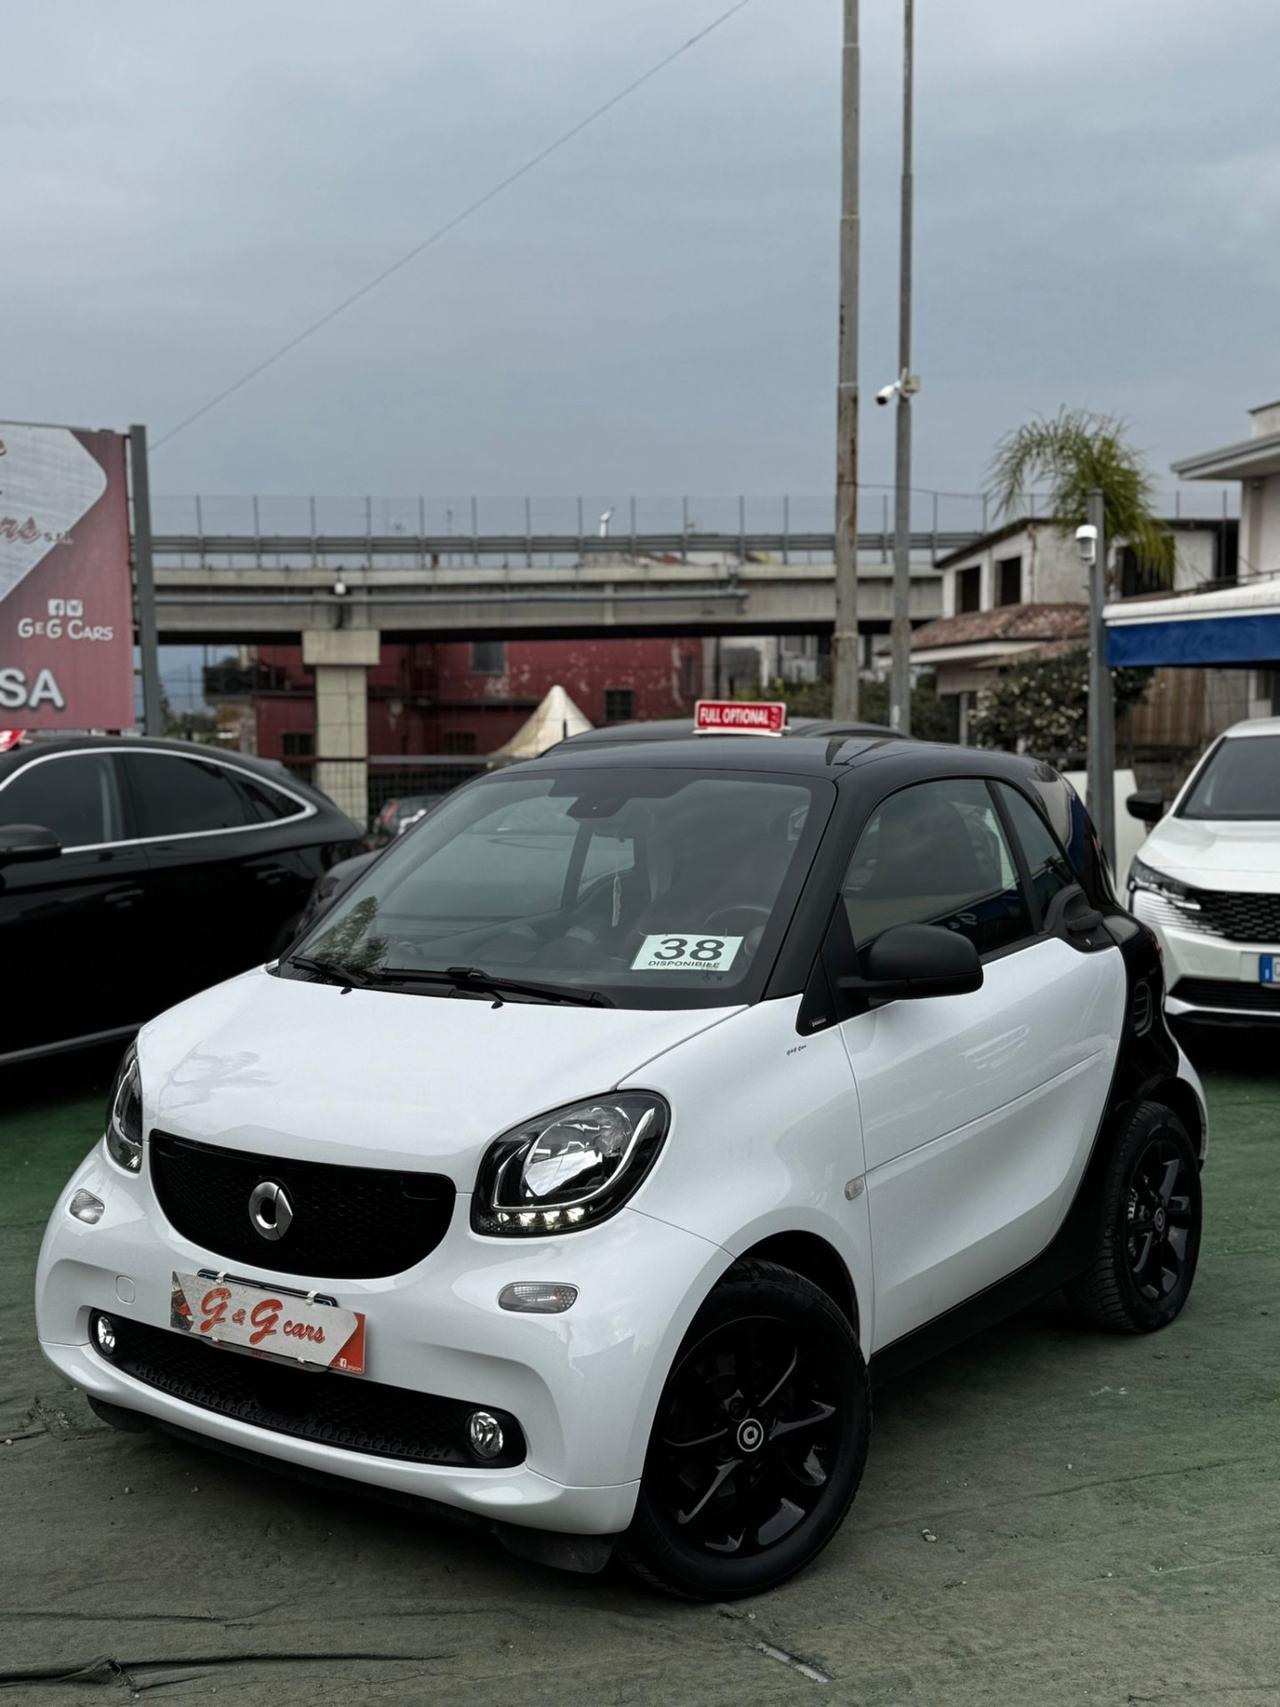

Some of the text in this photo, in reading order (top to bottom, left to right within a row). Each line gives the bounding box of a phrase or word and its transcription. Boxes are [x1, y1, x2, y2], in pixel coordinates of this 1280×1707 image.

[0, 668, 65, 708] SA
[700, 706, 769, 725] FULL OPTIONAL
[653, 938, 725, 962] 38
[282, 1319, 326, 1344] cars
